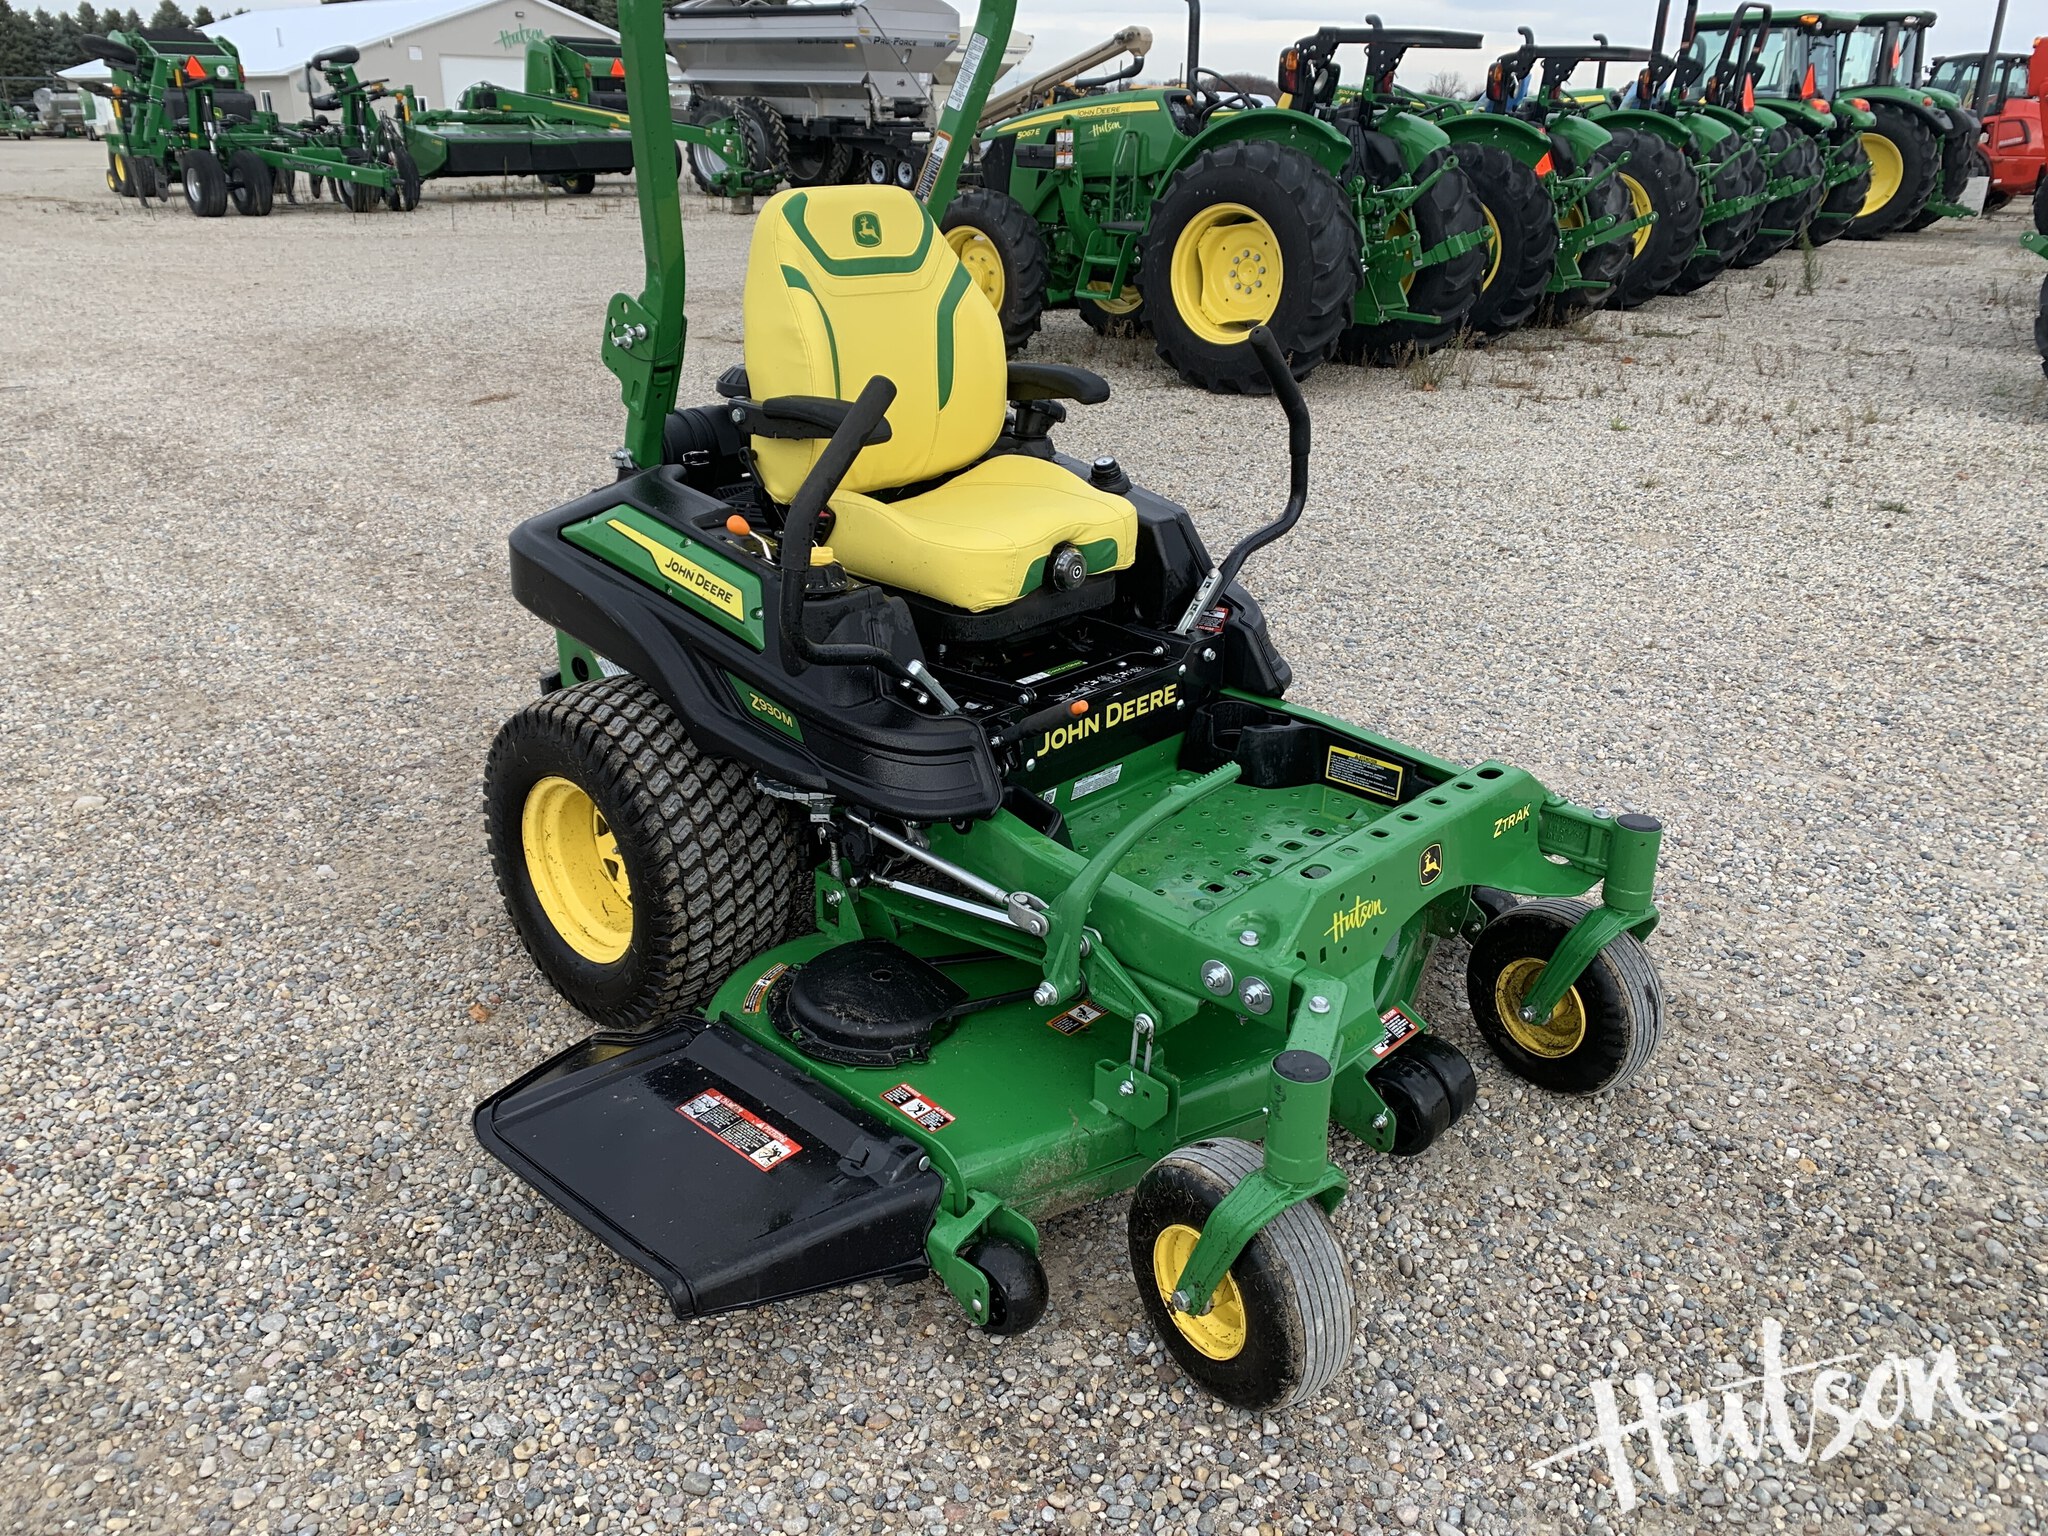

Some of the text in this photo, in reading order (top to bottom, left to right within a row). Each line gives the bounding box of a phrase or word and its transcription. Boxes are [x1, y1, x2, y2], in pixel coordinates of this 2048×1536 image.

[493, 23, 545, 50] Hutson
[1078, 106, 1121, 118] JOHN DEERE
[1088, 119, 1123, 137] Hutson
[664, 557, 733, 604] JOHN DEERE
[749, 692, 793, 728] Z930M
[1037, 712, 1099, 757] JOHN
[1106, 683, 1177, 729] DEERE
[1493, 802, 1531, 839] ZTRAK
[1323, 895, 1388, 944] Hutson
